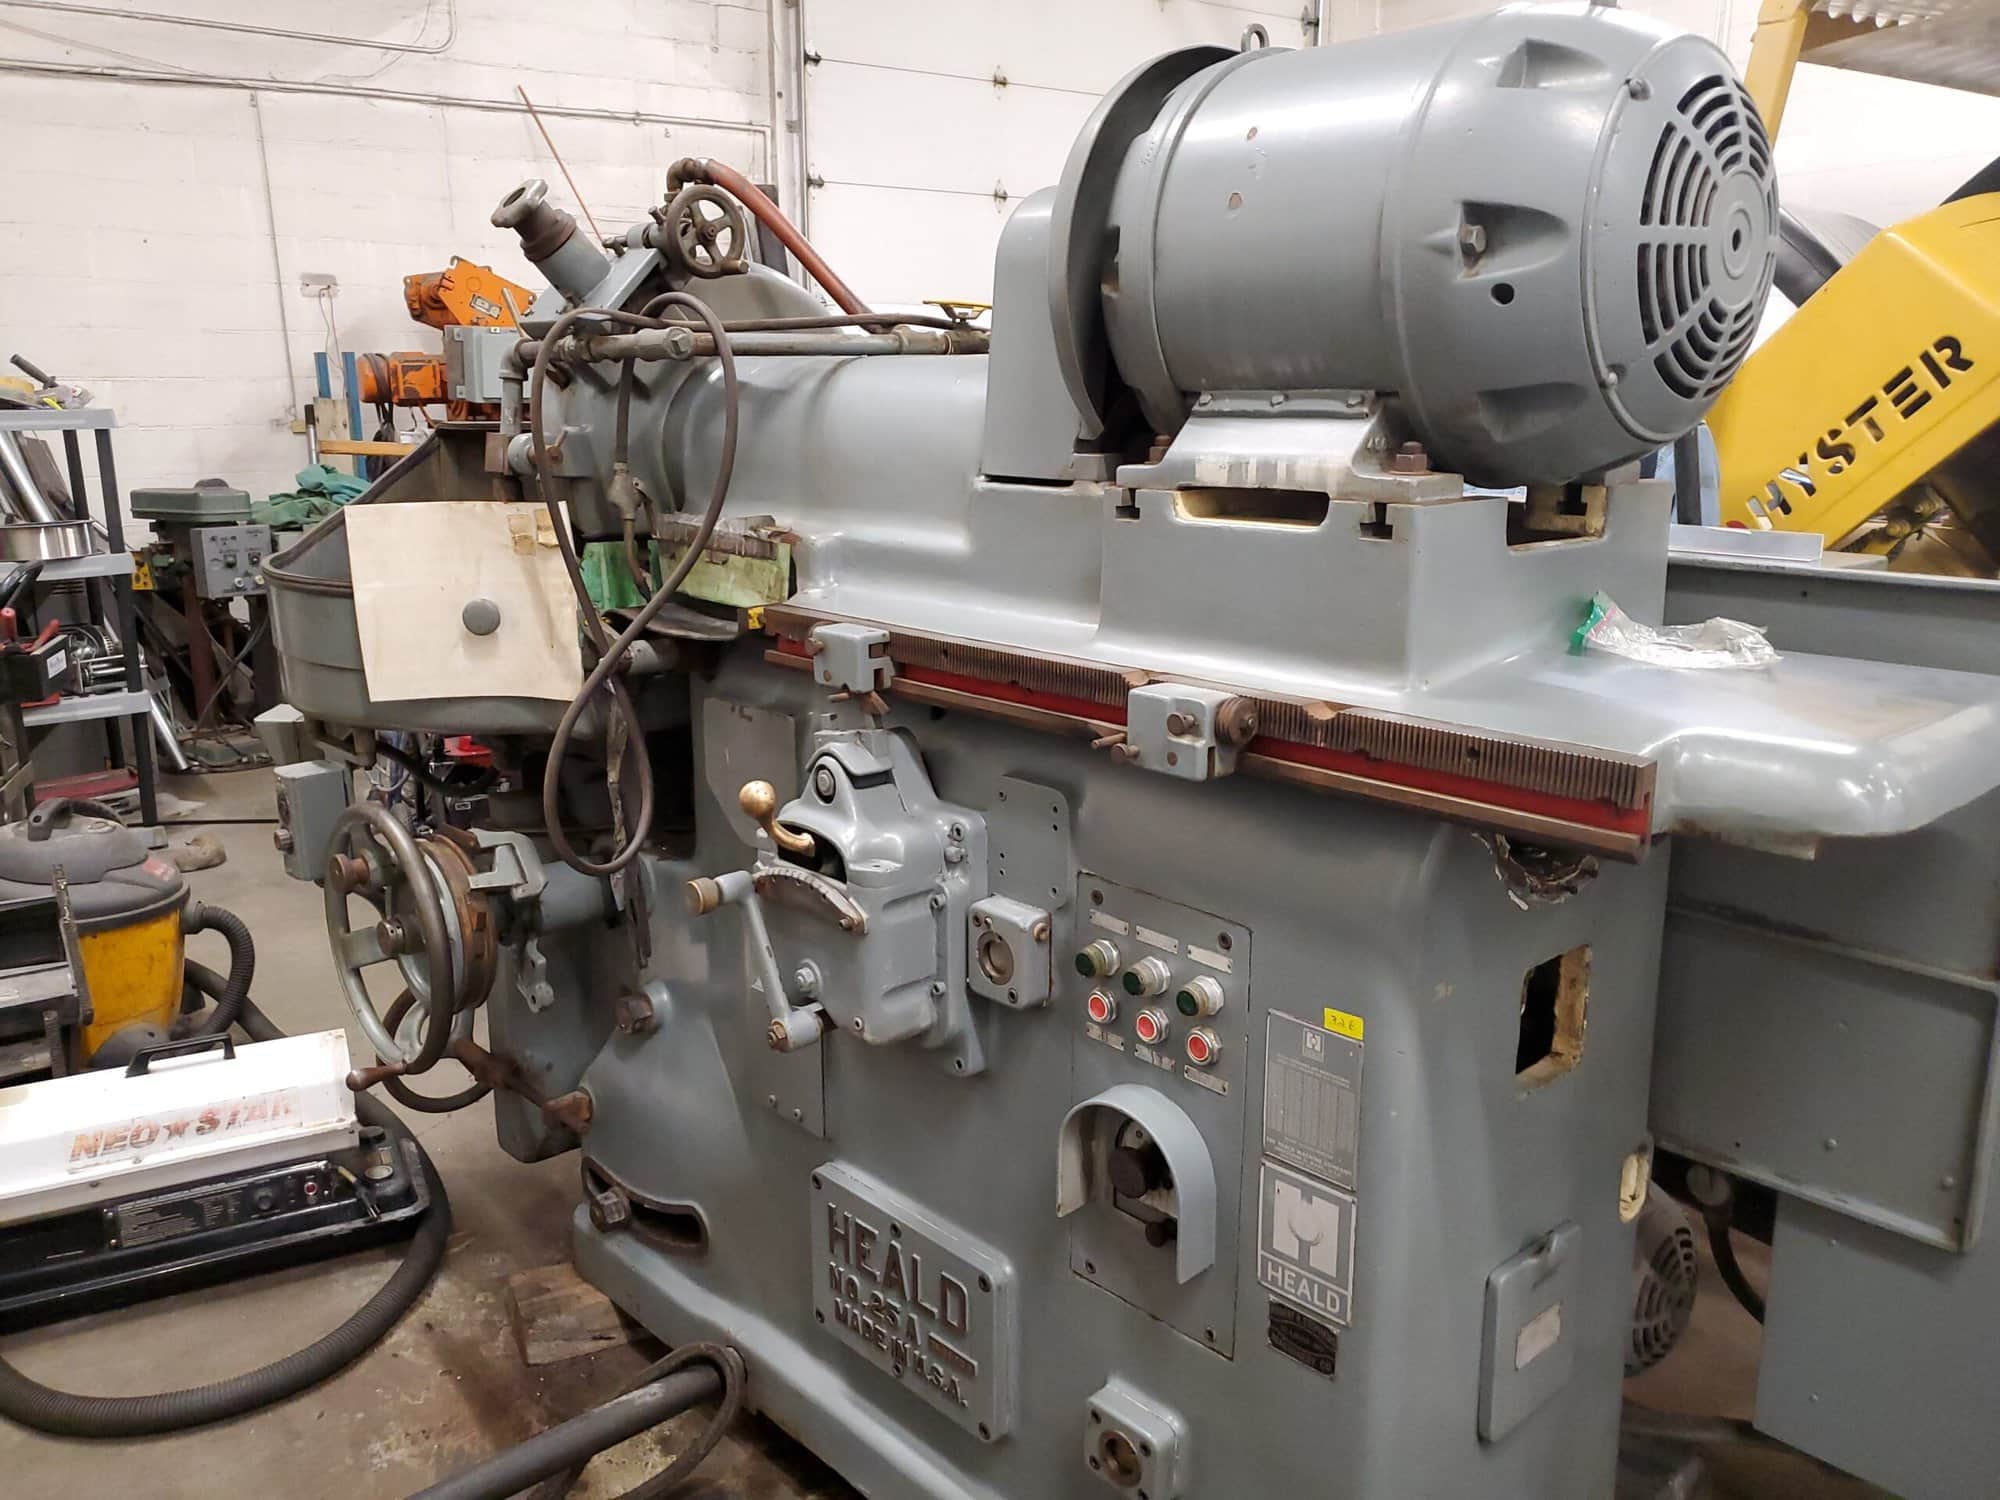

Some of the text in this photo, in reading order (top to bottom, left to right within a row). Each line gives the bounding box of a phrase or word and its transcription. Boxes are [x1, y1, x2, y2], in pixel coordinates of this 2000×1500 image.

[1746, 334, 1974, 531] HYSTER
[828, 1202, 969, 1334] HEALD
[1267, 1260, 1341, 1313] HEALD
[834, 1297, 888, 1350] MADE
[891, 1335, 911, 1368] IN
